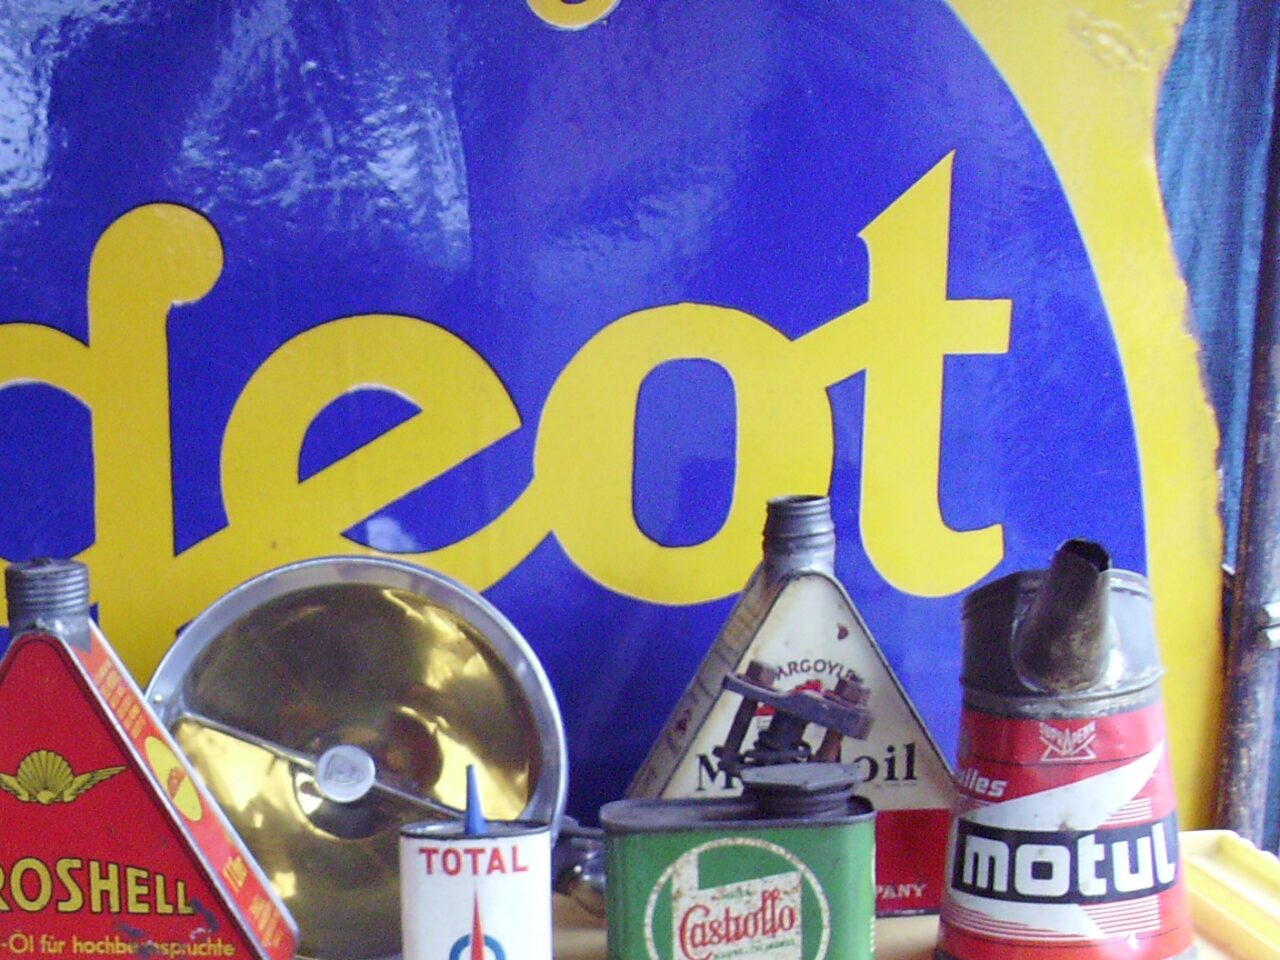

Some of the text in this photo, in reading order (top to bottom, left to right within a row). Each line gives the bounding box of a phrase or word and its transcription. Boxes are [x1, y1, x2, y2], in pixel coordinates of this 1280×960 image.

[418, 846, 529, 876] TOTAL
[962, 822, 1176, 897] motul
[40, 934, 66, 954] für
